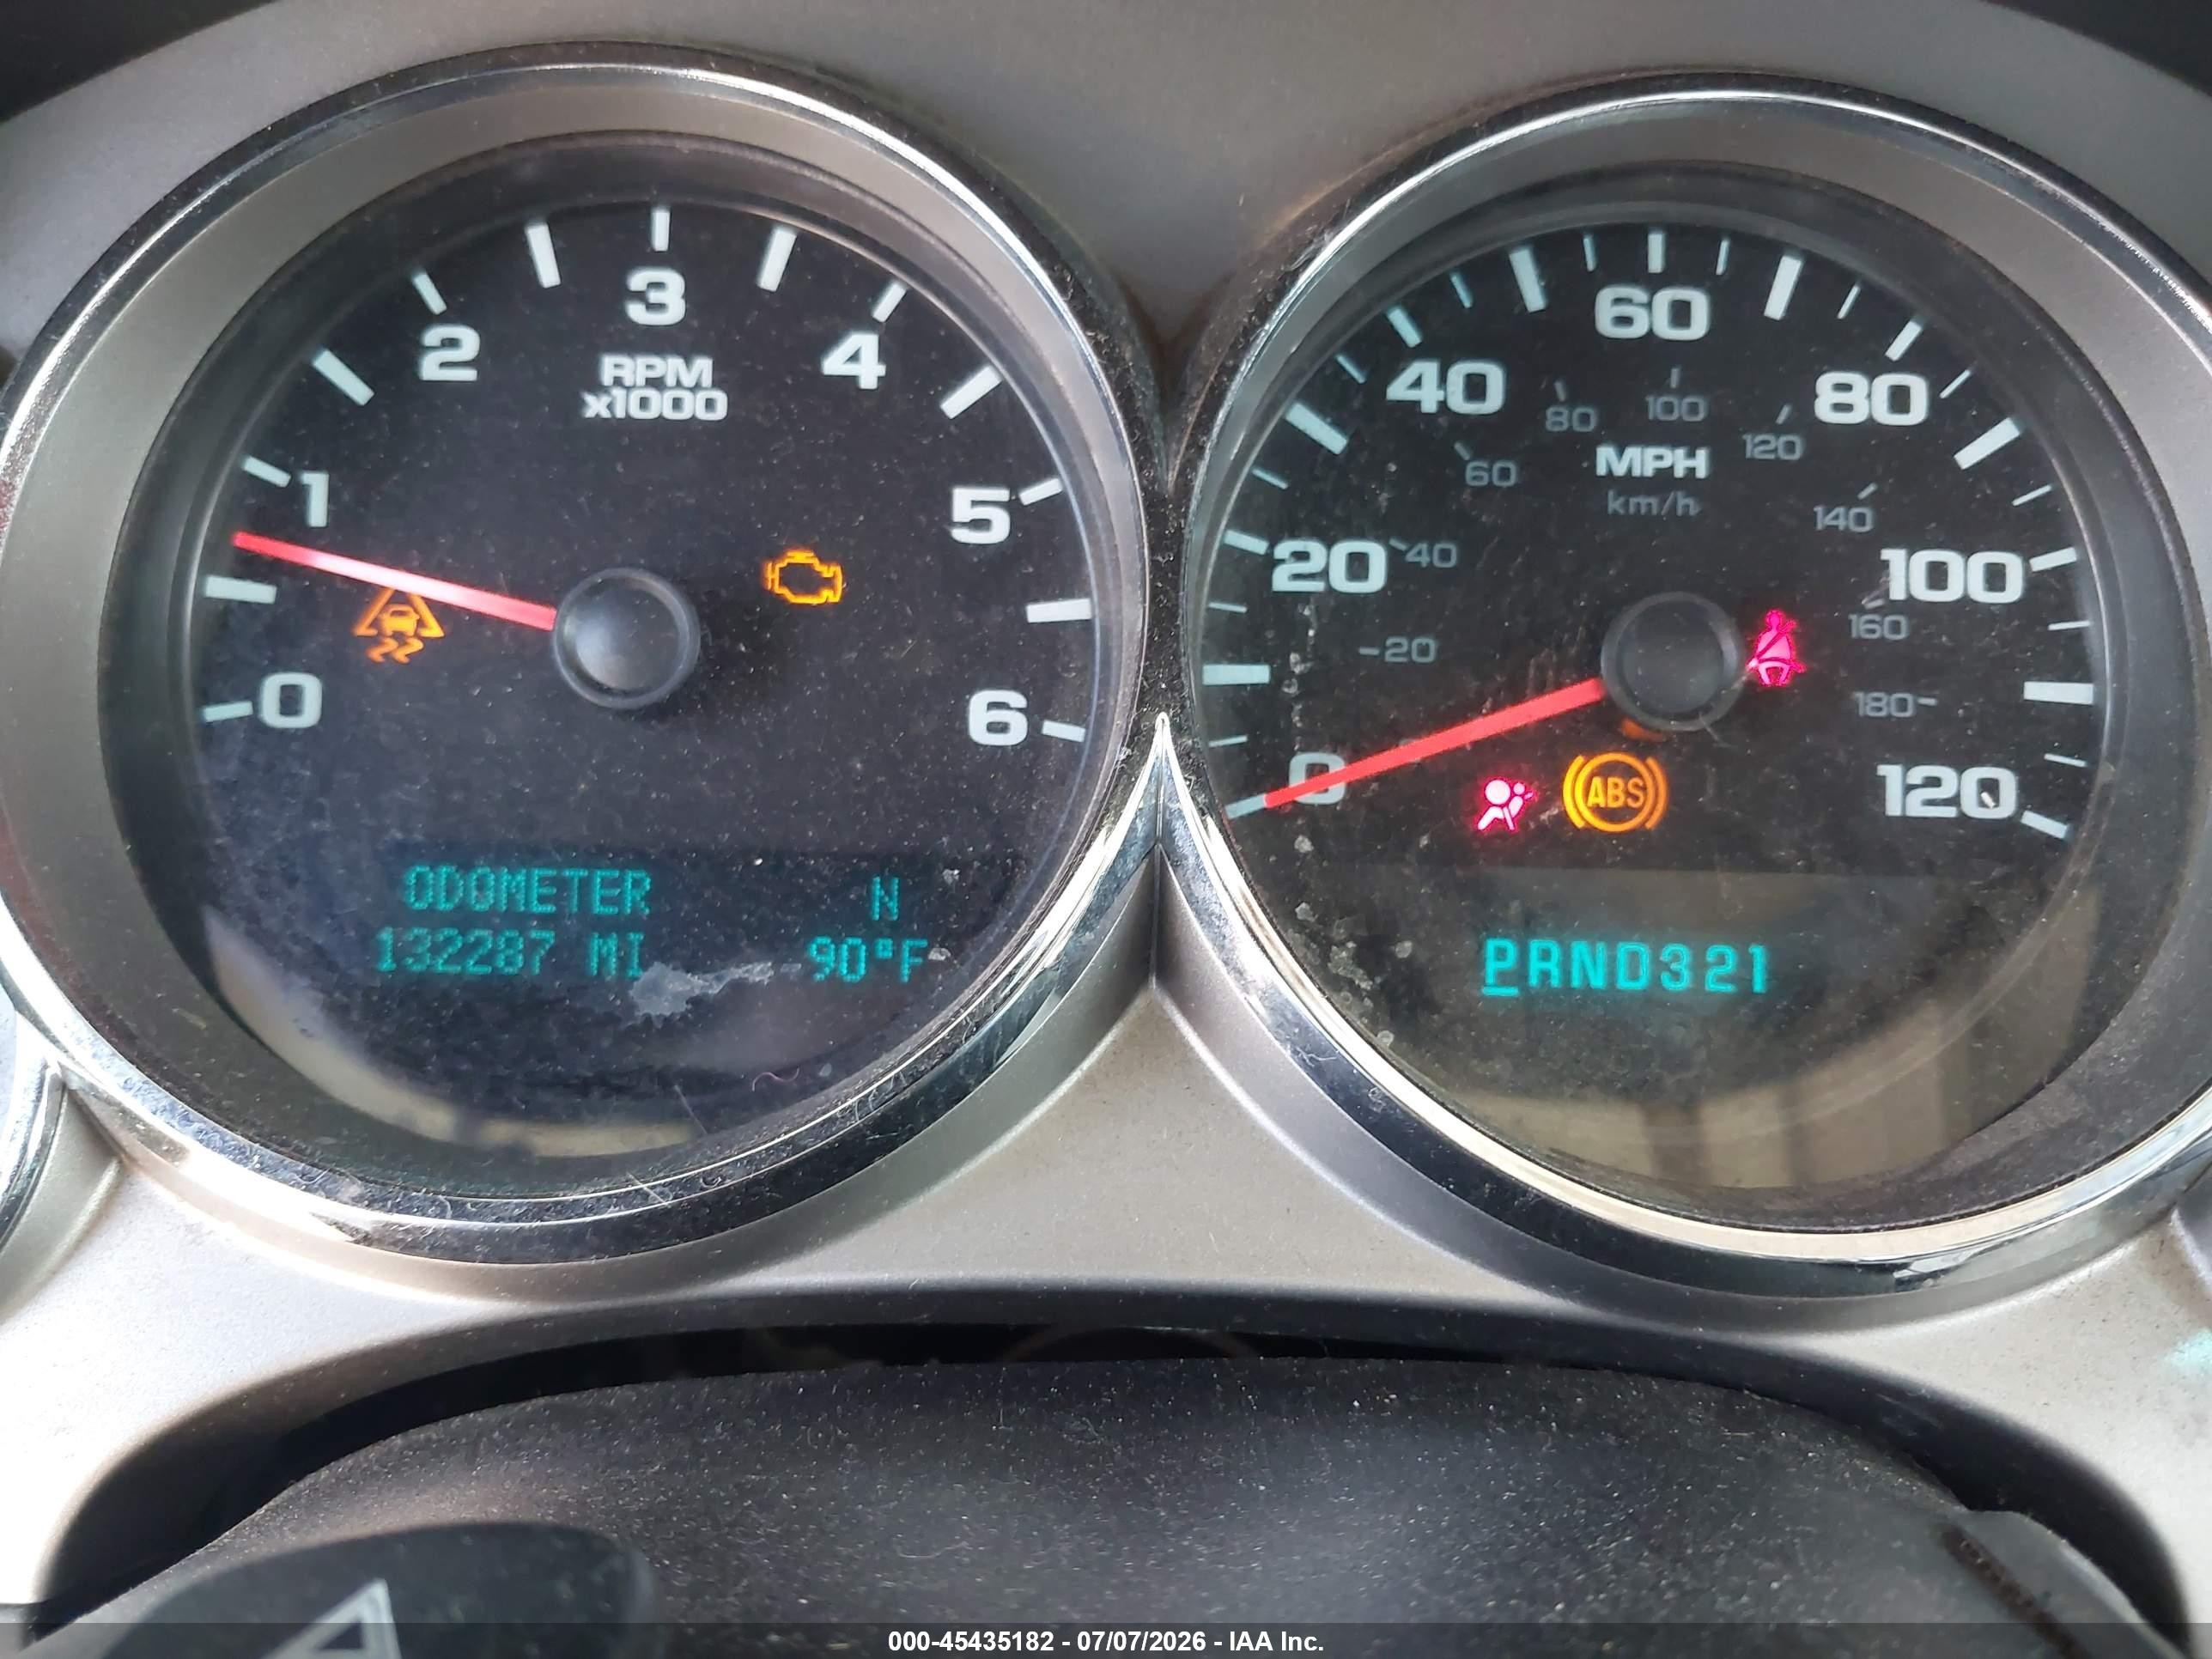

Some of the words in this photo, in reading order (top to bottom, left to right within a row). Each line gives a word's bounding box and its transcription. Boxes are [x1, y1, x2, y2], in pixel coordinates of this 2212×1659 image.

[626, 267, 686, 325] 3
[1594, 285, 1711, 341] 60
[419, 324, 481, 381] 2
[601, 355, 714, 388] RPM
[821, 332, 885, 390] 4
[582, 389, 728, 421] x1000
[1385, 358, 1506, 415] 40
[1646, 395, 1707, 422] 100
[1814, 372, 1929, 426] 80
[1546, 407, 1597, 433] 80
[1595, 446, 1707, 479] MPH
[1743, 433, 1803, 460] 120
[1465, 460, 1516, 487] 60
[300, 471, 329, 527] 1
[950, 487, 1011, 544] 5
[1607, 491, 1702, 517] km/h
[1814, 505, 1875, 532] 140
[1272, 539, 1388, 594] 20
[1405, 541, 1458, 568] 40
[1881, 548, 2024, 604] 100
[1384, 637, 1437, 663] 20
[1849, 613, 1910, 641] 160
[258, 672, 324, 730] 0
[967, 689, 1029, 746] 6
[1856, 691, 1916, 718] 180
[1289, 751, 1346, 805] 0
[1586, 775, 1646, 809] ABS
[1875, 763, 2020, 821] 120
[403, 866, 652, 915] ODOMETER
[868, 876, 900, 921] N
[374, 927, 555, 976] 132287
[584, 932, 645, 978] MI
